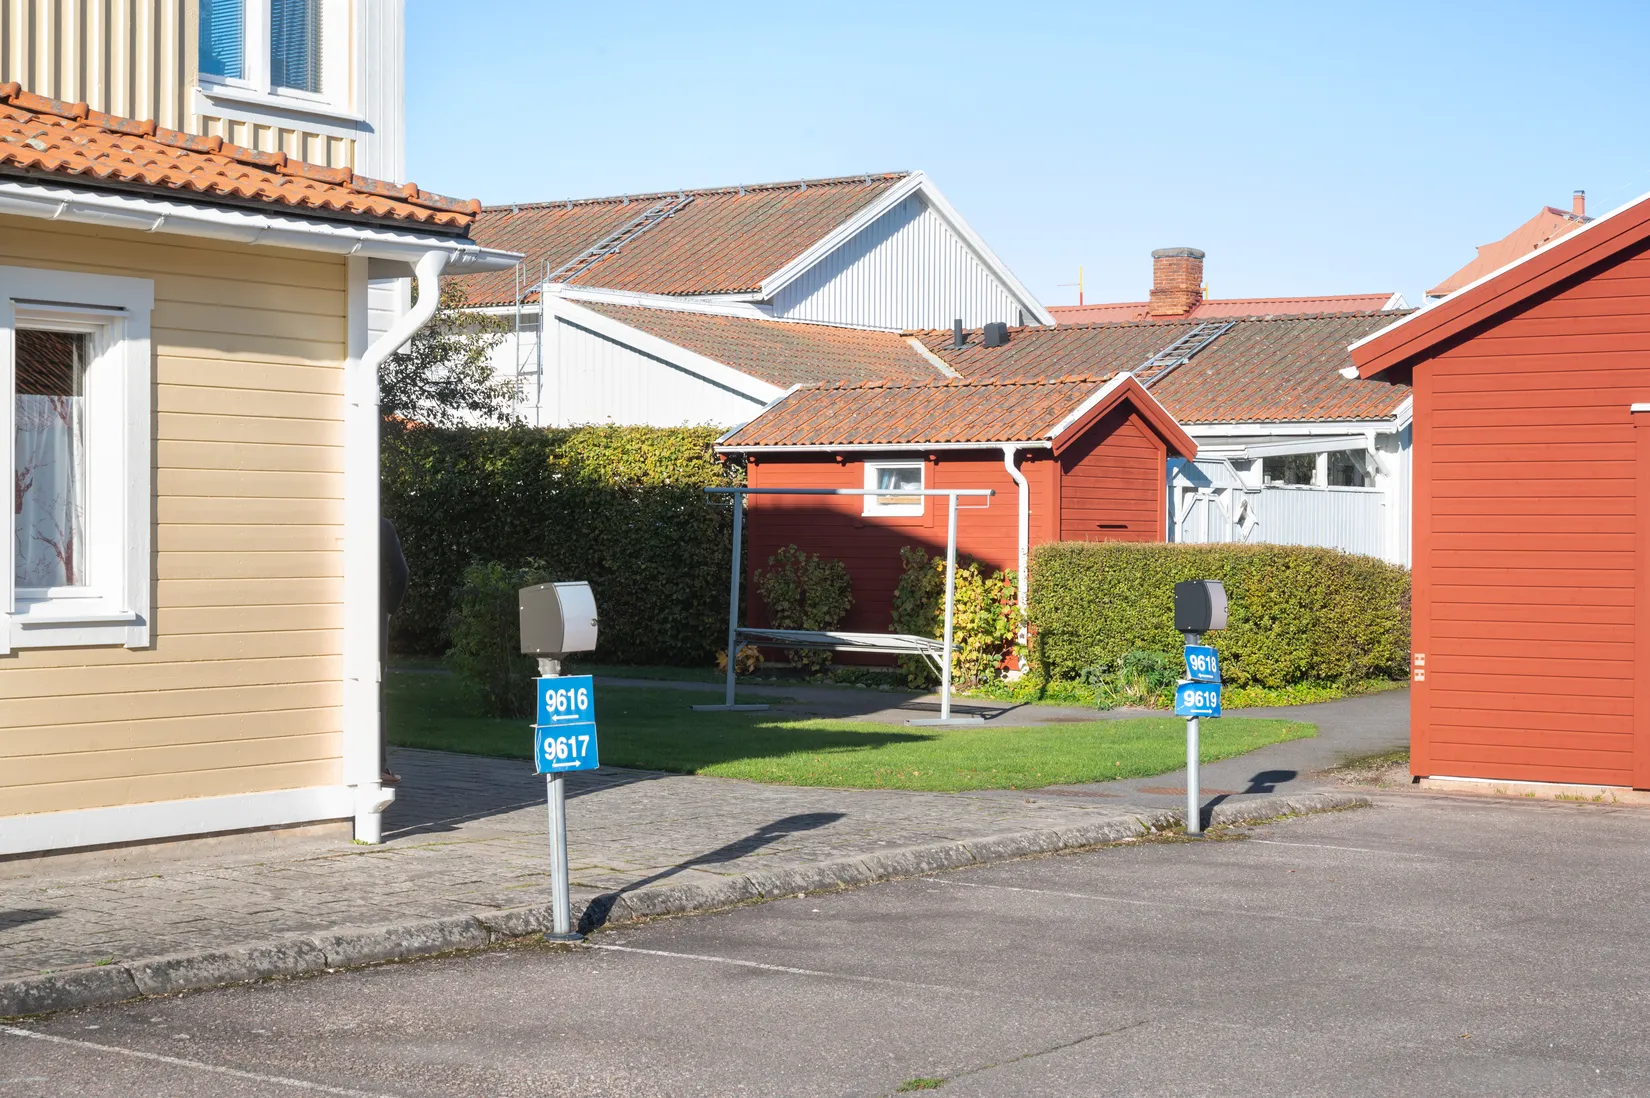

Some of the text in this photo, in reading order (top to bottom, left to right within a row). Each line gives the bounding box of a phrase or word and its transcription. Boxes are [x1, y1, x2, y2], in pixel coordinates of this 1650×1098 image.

[1190, 654, 1217, 672] 9618
[545, 688, 588, 712] 9616
[1184, 690, 1217, 708] 9619
[544, 735, 590, 760] 9617
